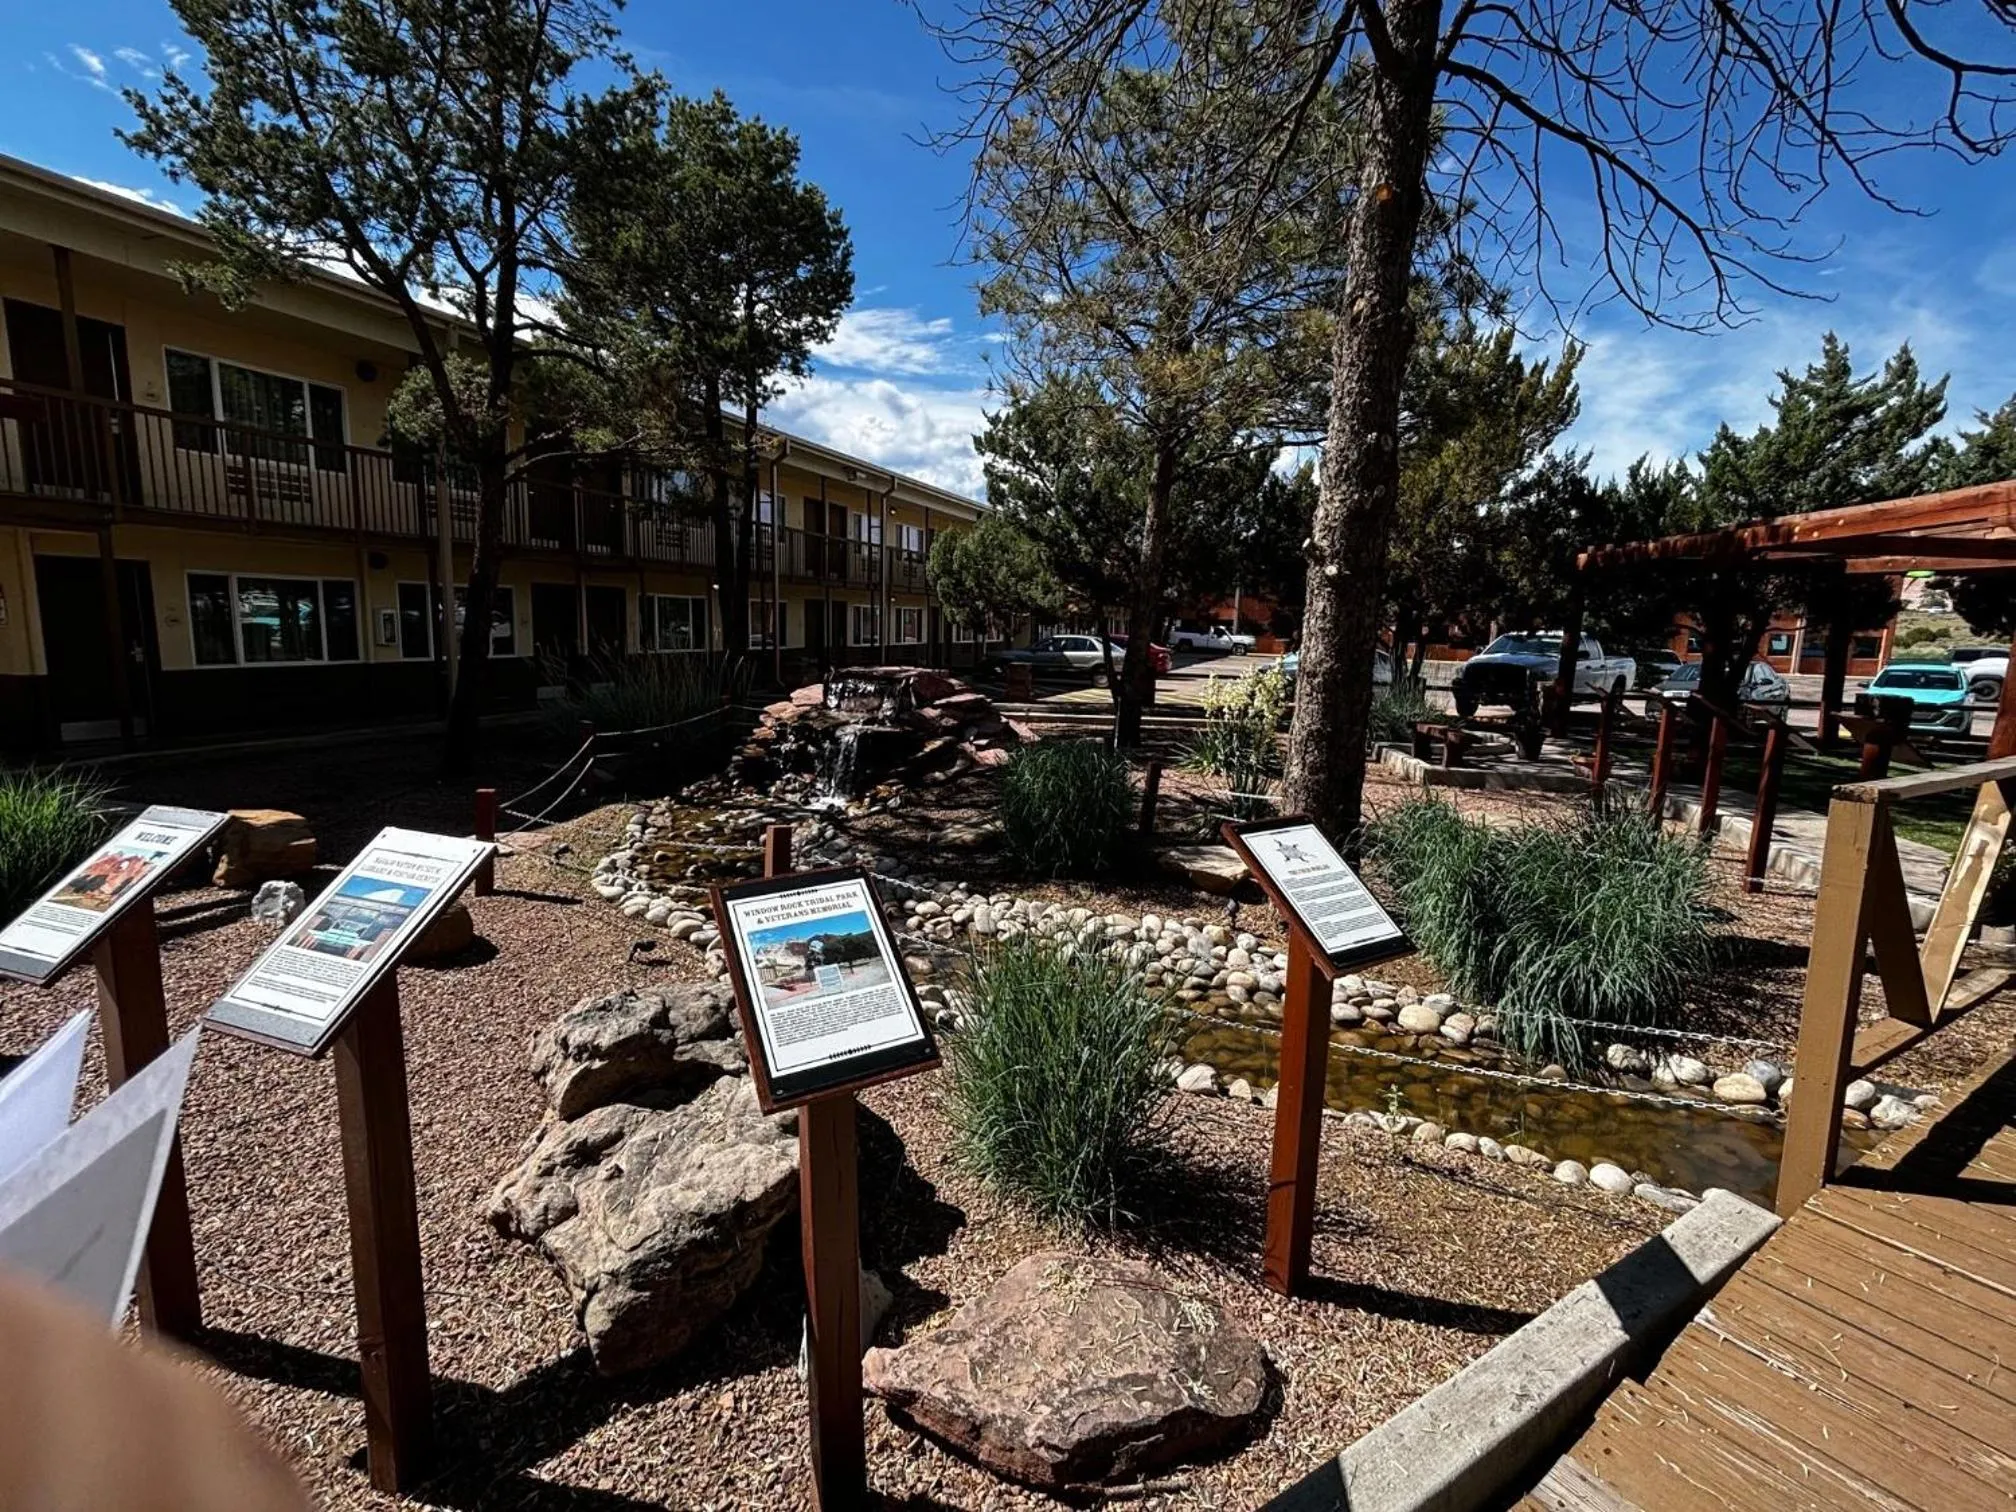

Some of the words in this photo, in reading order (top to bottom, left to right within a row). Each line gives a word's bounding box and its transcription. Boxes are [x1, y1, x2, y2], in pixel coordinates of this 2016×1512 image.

[743, 906, 780, 917] WINDOW
[780, 901, 803, 912] ROCK
[805, 895, 835, 907] TRIBAL
[836, 891, 859, 901] PARK
[764, 910, 810, 923] VETERANS
[810, 901, 853, 915] MEMORIAL
